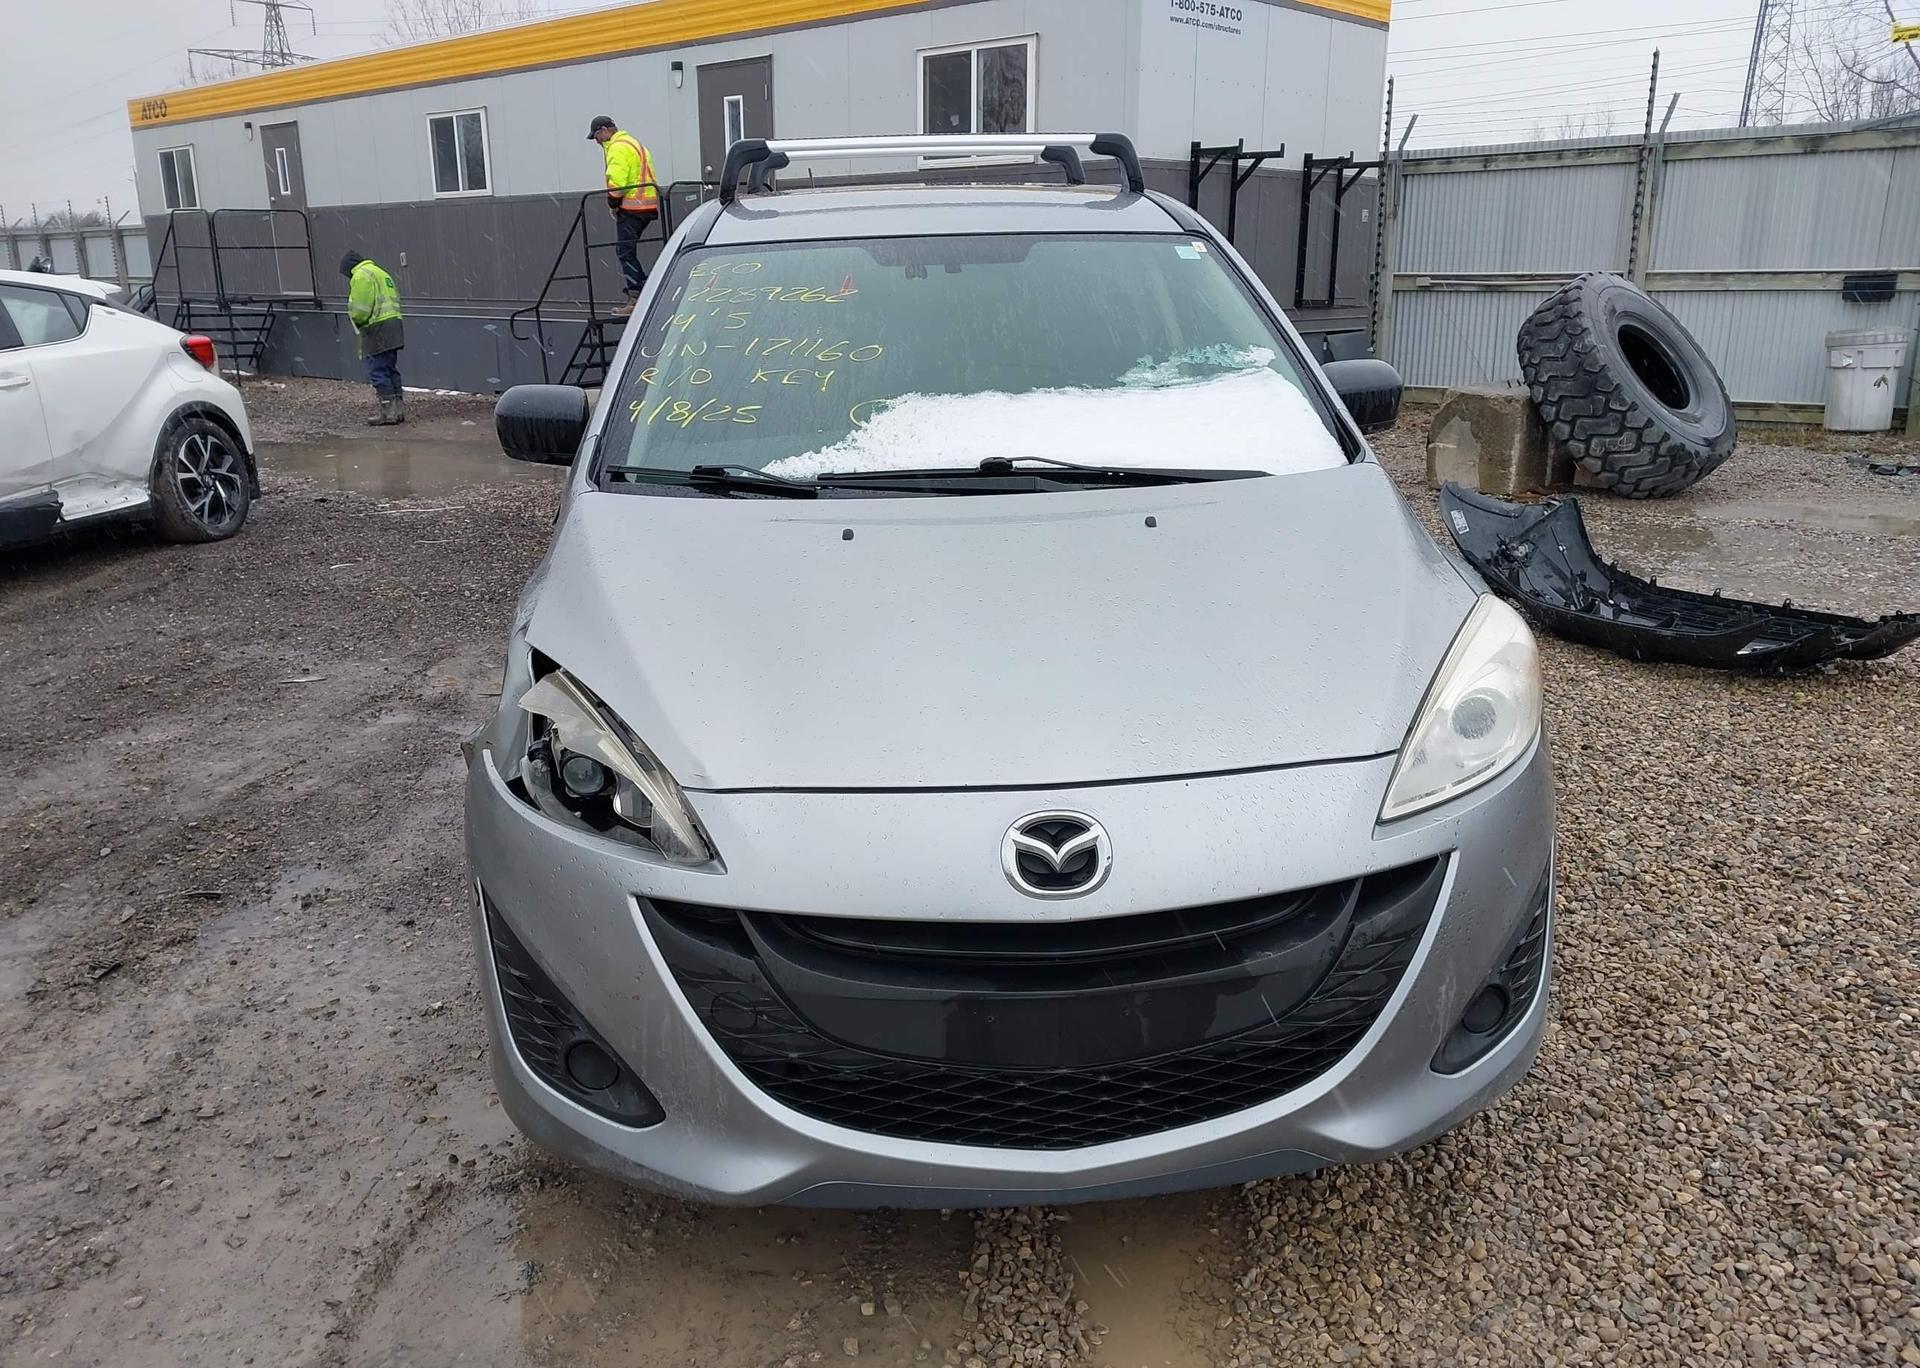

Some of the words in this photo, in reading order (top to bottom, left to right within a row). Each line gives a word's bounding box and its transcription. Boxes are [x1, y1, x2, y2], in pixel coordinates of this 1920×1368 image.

[1169, 16, 1241, 35] www.ATCO.com/structures
[141, 99, 167, 120] ATCO
[750, 368, 835, 392] KEY
